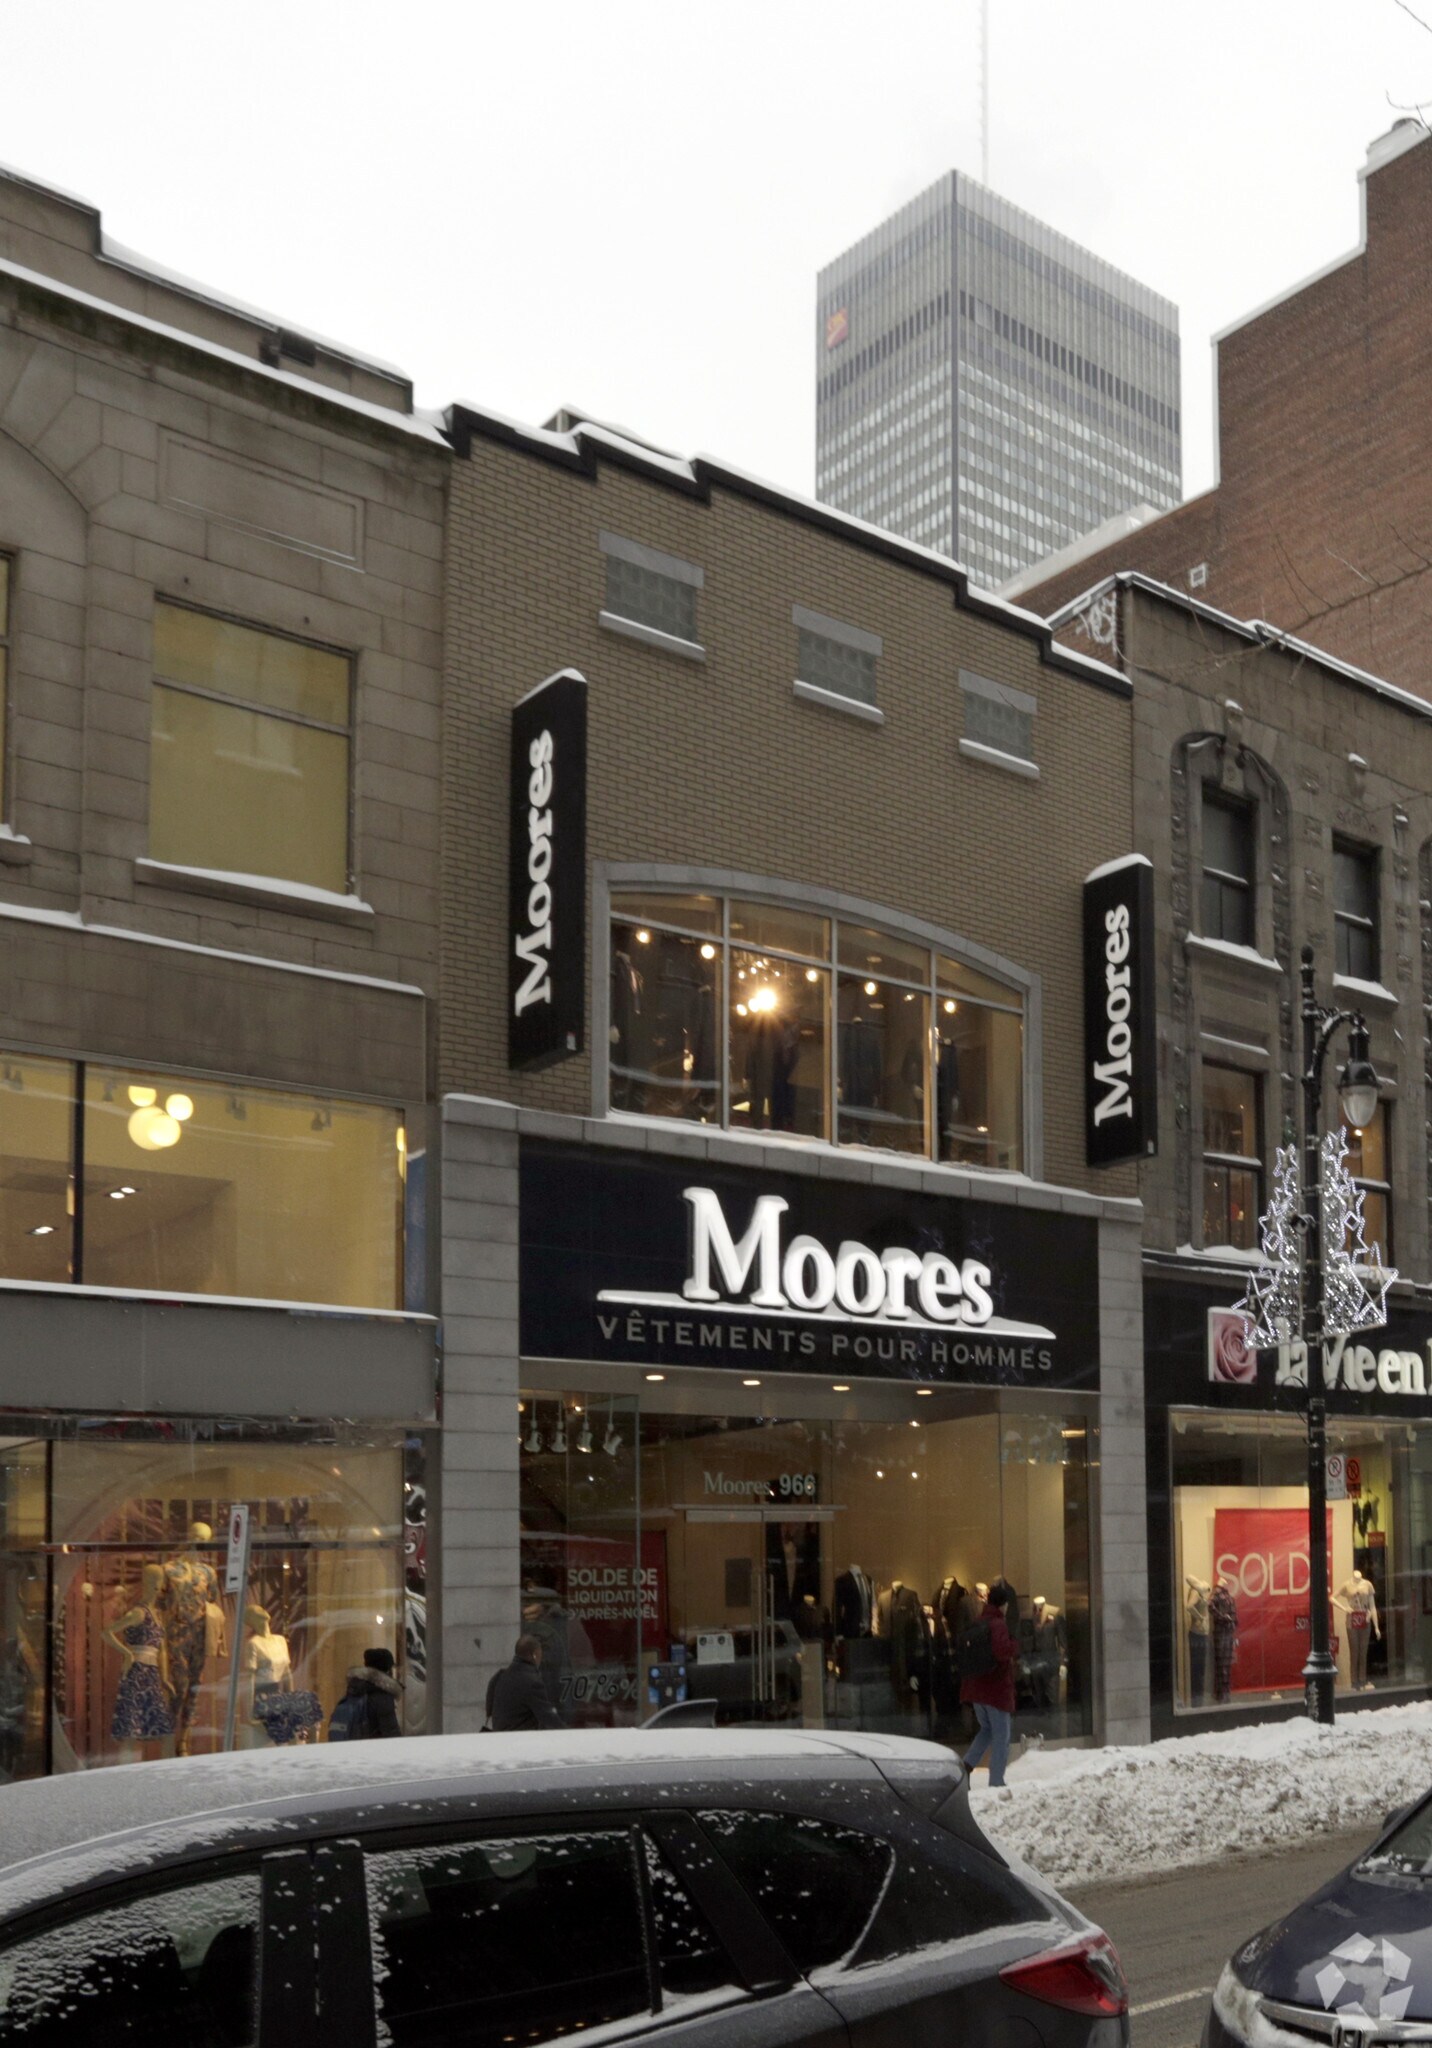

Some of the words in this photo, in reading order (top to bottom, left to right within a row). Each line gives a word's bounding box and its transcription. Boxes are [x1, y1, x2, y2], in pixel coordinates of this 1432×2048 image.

[515, 728, 553, 1017] Moores
[1094, 903, 1133, 1127] Moores
[682, 1186, 994, 1325] Moores
[597, 1310, 816, 1354] VÊTEMENTS
[831, 1334, 917, 1361] POUR
[931, 1342, 1052, 1370] HOMMES
[1377, 1349, 1427, 1396] en
[703, 1471, 771, 1496] Moores
[779, 1473, 816, 1496] 966
[567, 1568, 628, 1586] SOLDE
[633, 1568, 658, 1586] DE
[567, 1590, 658, 1604] LIQUIDATION
[1216, 1552, 1330, 1598] SOLD
